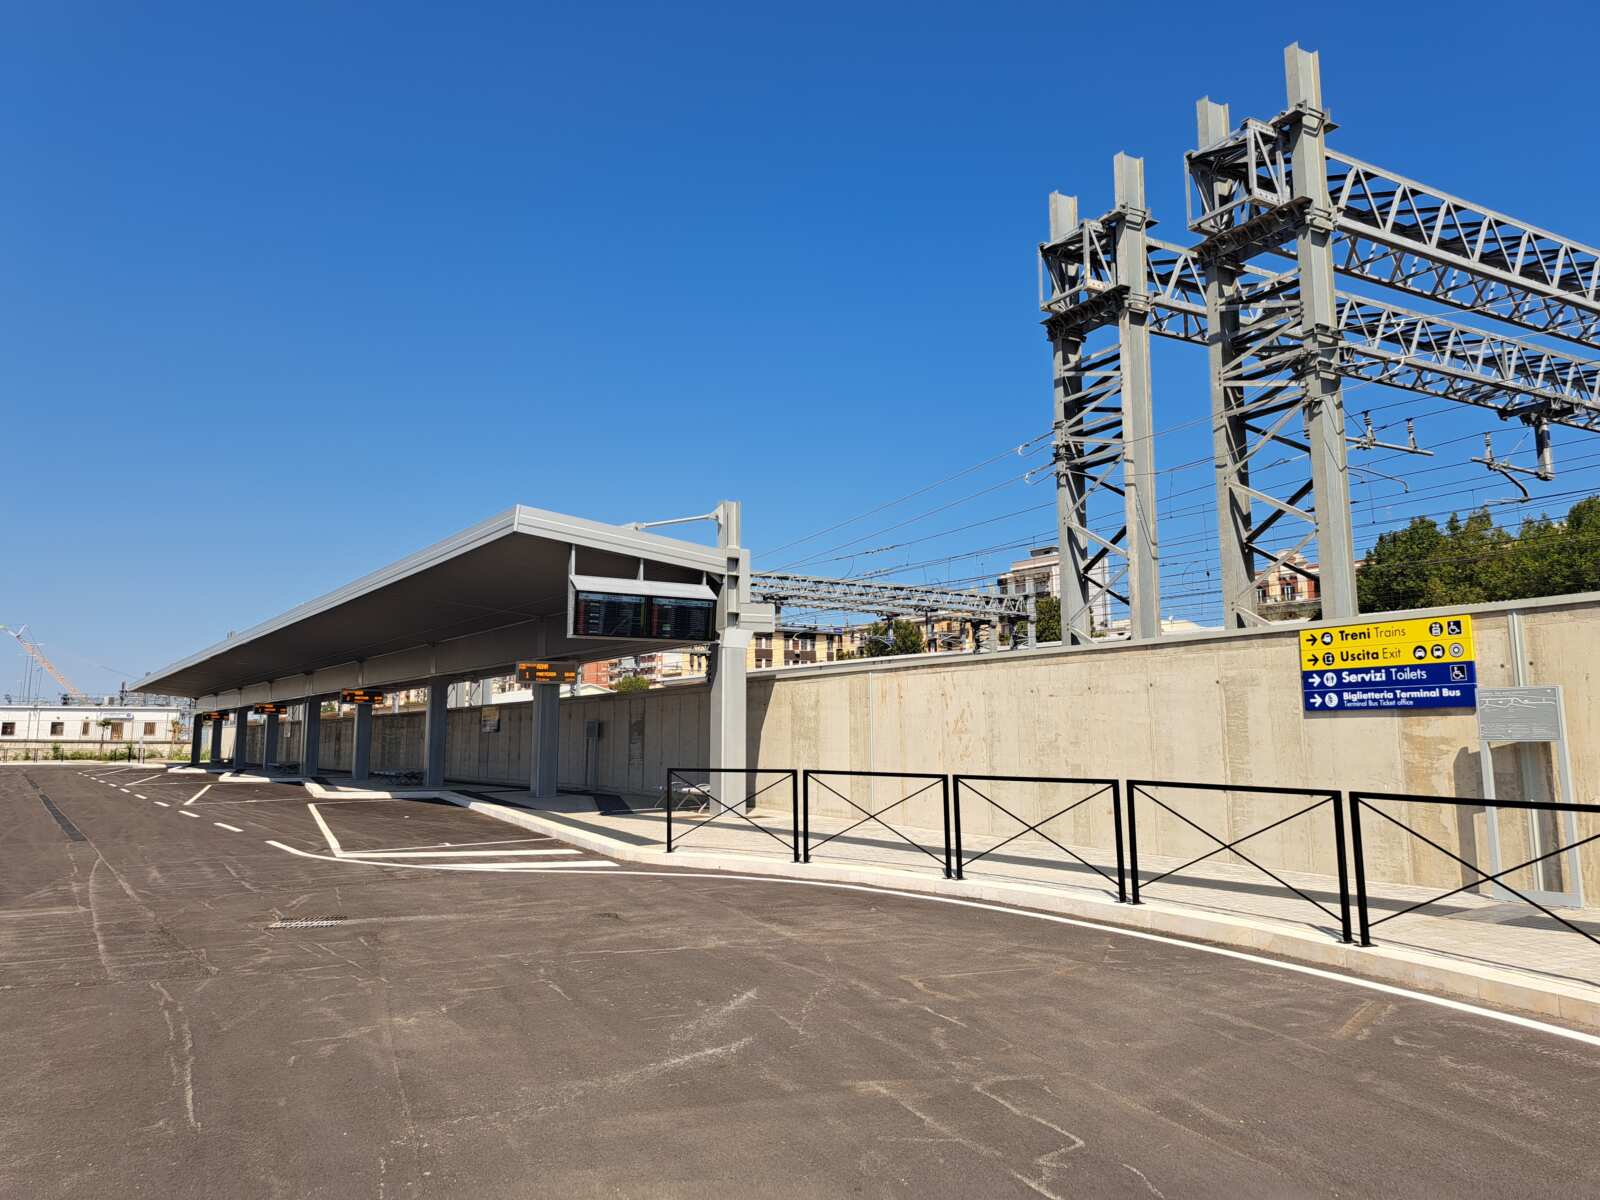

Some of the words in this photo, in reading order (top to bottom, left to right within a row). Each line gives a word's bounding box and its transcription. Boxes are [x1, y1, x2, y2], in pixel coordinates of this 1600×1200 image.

[1339, 628, 1370, 641] Treni
[1374, 626, 1406, 638] Trains
[1341, 650, 1379, 662] Uscita
[1382, 647, 1401, 659] Exit
[1342, 669, 1386, 683] Servizi
[1390, 667, 1427, 681] Toilets
[1343, 690, 1393, 702] Biglietteria
[1395, 688, 1440, 698] Terminal
[1442, 688, 1461, 697] Bus
